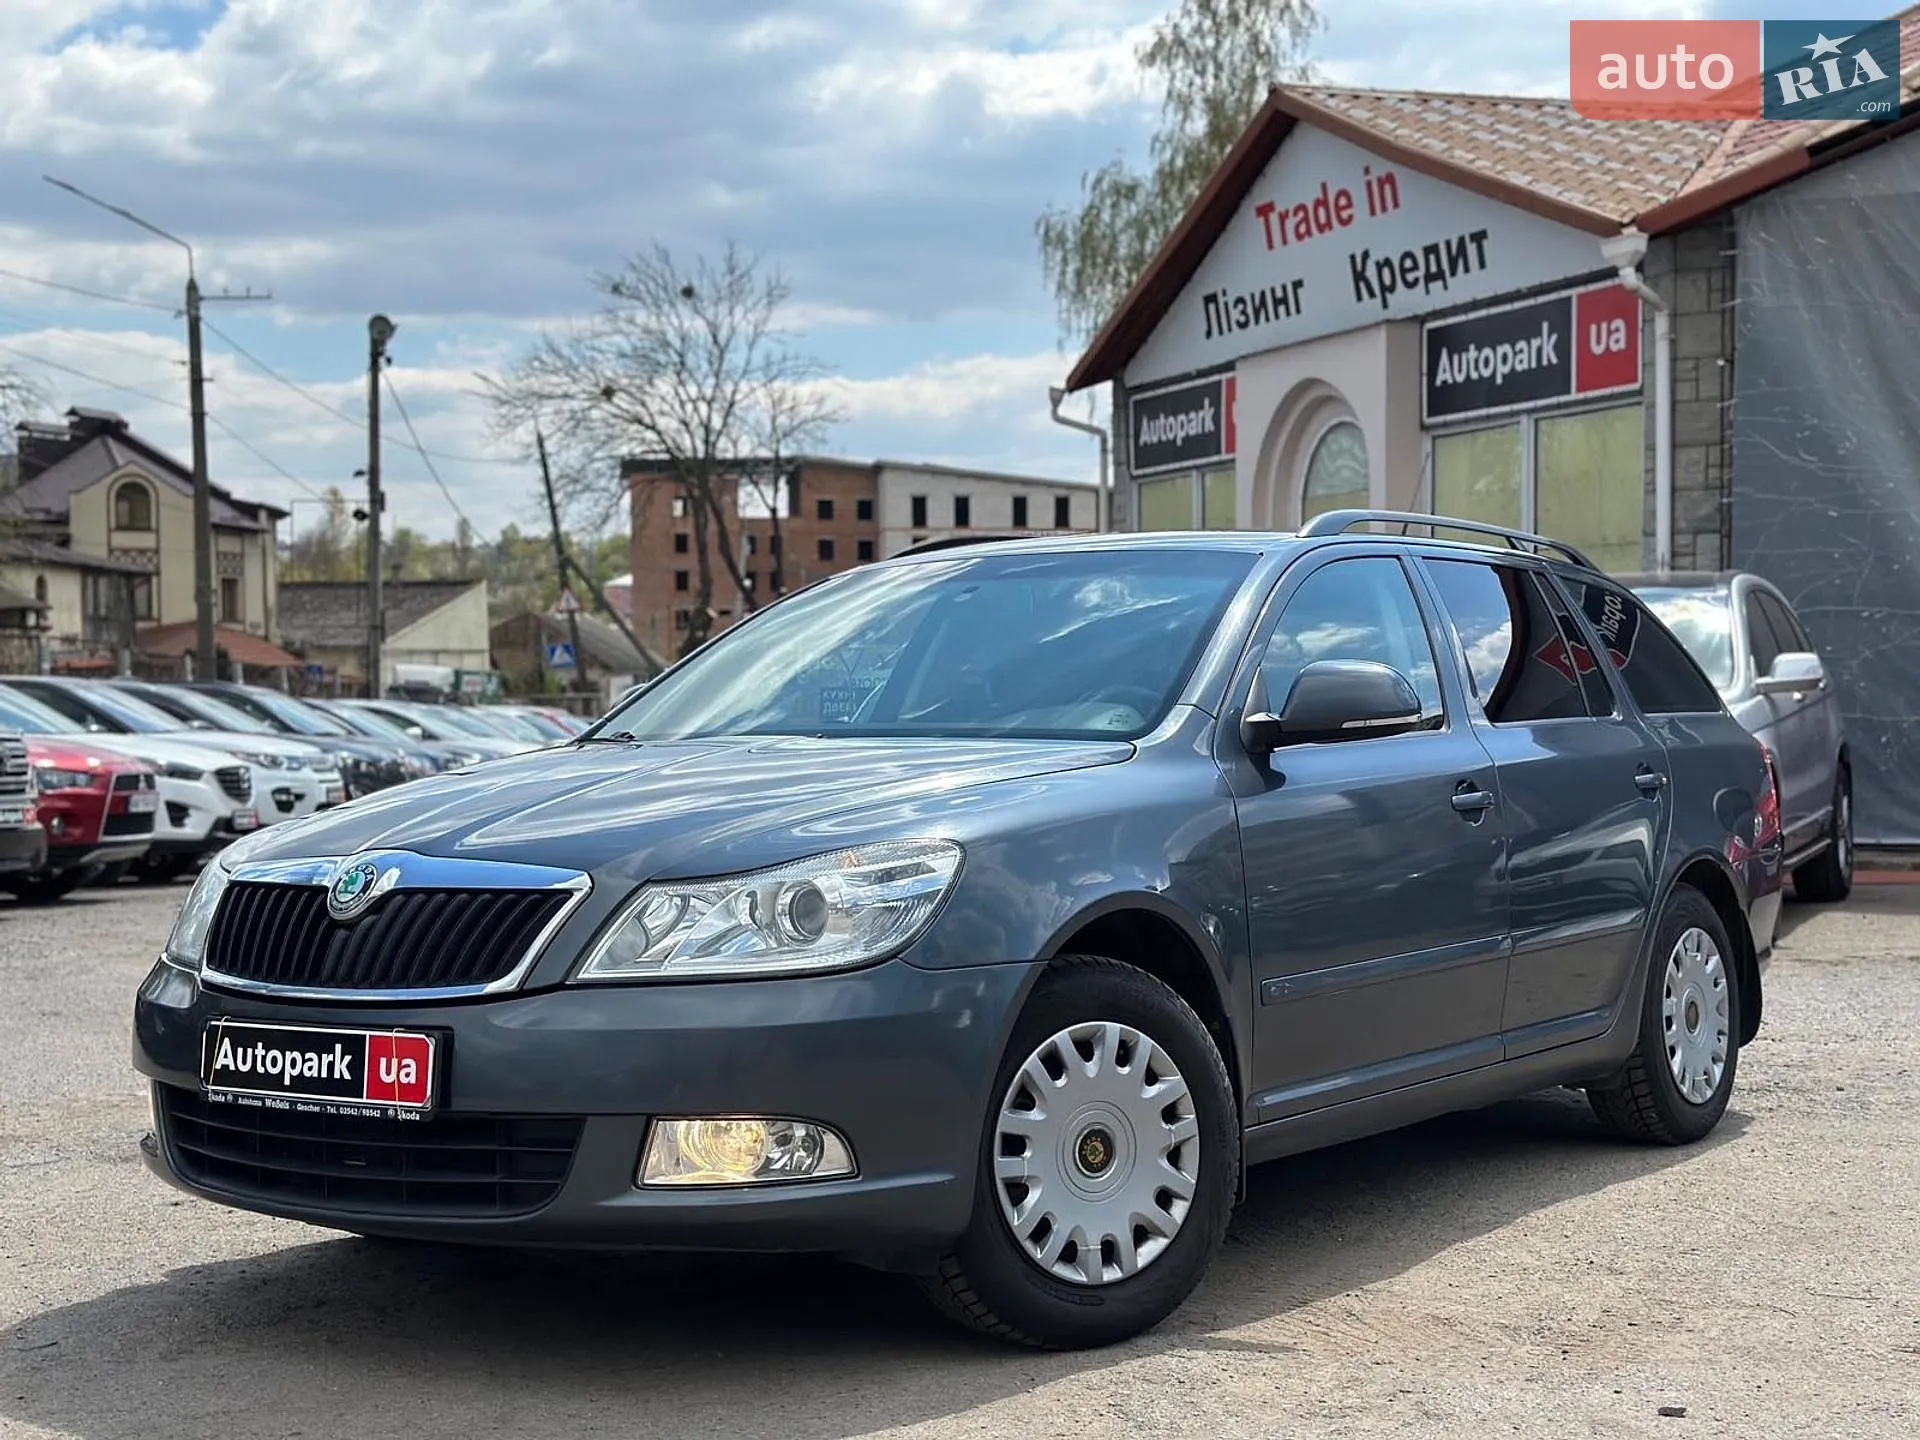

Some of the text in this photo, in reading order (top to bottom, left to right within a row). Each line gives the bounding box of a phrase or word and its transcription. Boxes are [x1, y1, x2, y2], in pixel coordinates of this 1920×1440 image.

[1255, 165, 1400, 251] Trade in
[1202, 228, 1489, 340] Лізинг Кредит
[1435, 317, 1637, 387] Autopark ua
[1139, 396, 1215, 447] Autopark
[215, 1037, 416, 1085] Autopark ua
